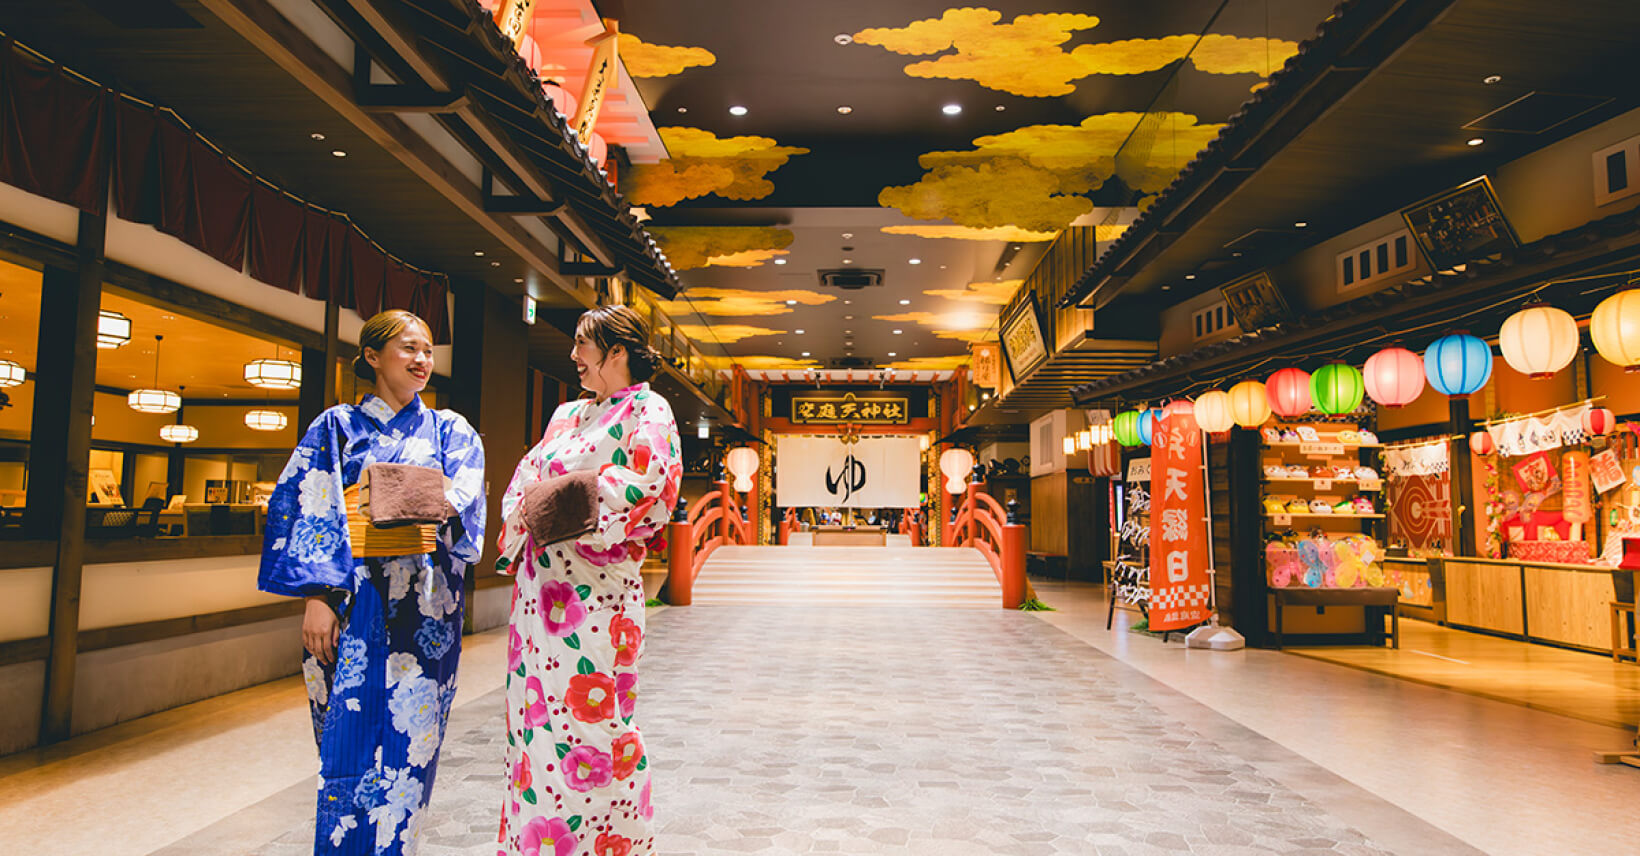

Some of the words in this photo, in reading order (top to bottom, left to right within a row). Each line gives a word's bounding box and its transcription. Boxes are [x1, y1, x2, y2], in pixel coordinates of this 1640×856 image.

[798, 402, 903, 418] 空庭天神社
[826, 454, 866, 503] ゆ
